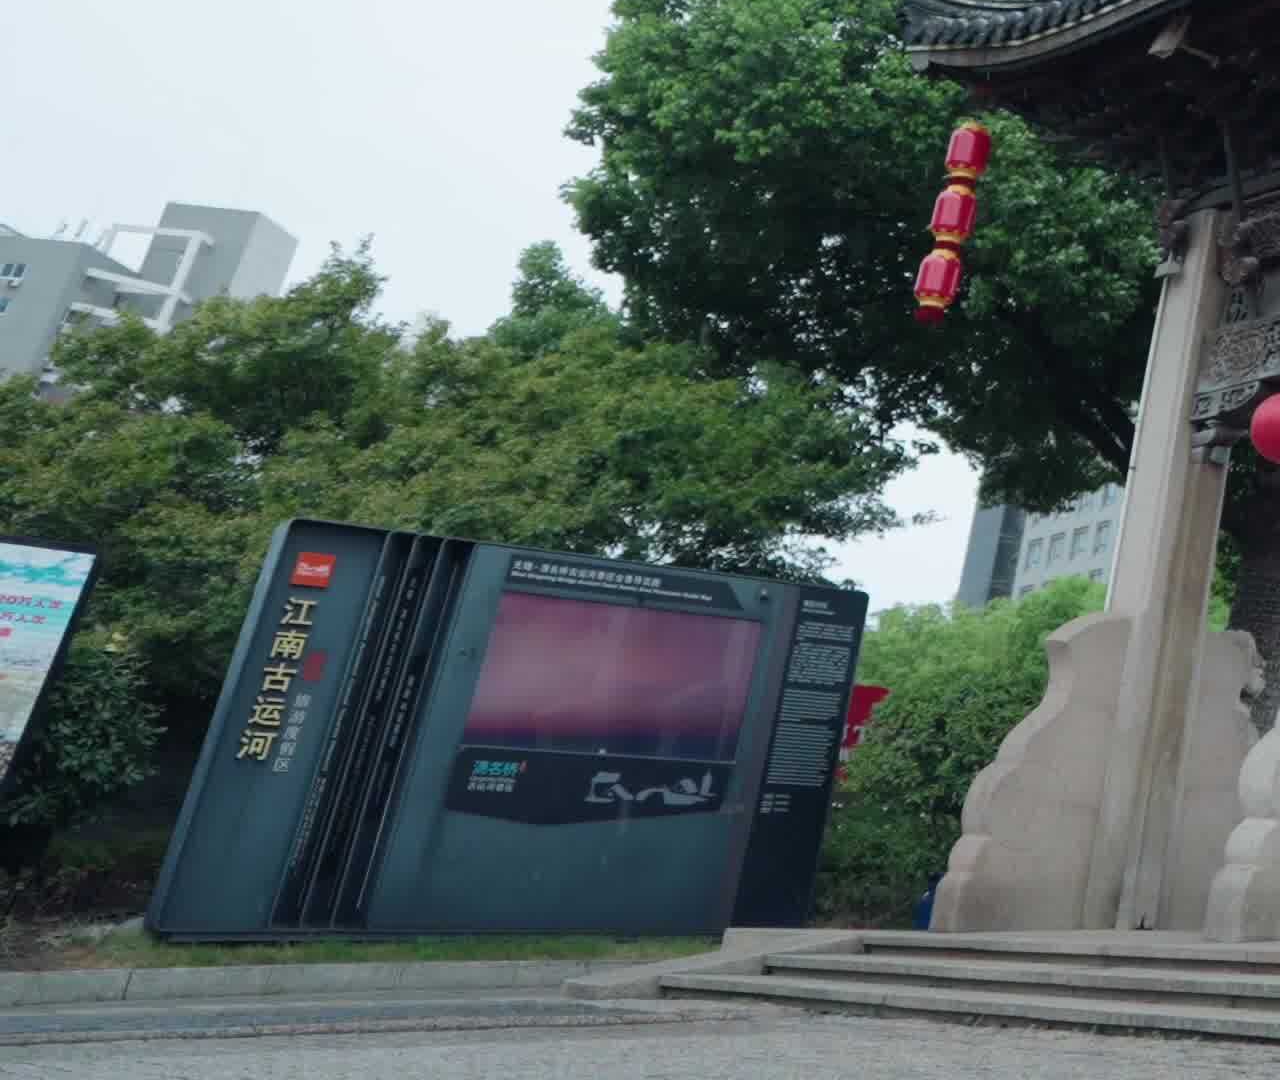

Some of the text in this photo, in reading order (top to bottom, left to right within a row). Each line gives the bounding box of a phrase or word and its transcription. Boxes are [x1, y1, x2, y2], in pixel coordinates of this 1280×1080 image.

[235, 596, 318, 761] 江南古运河
